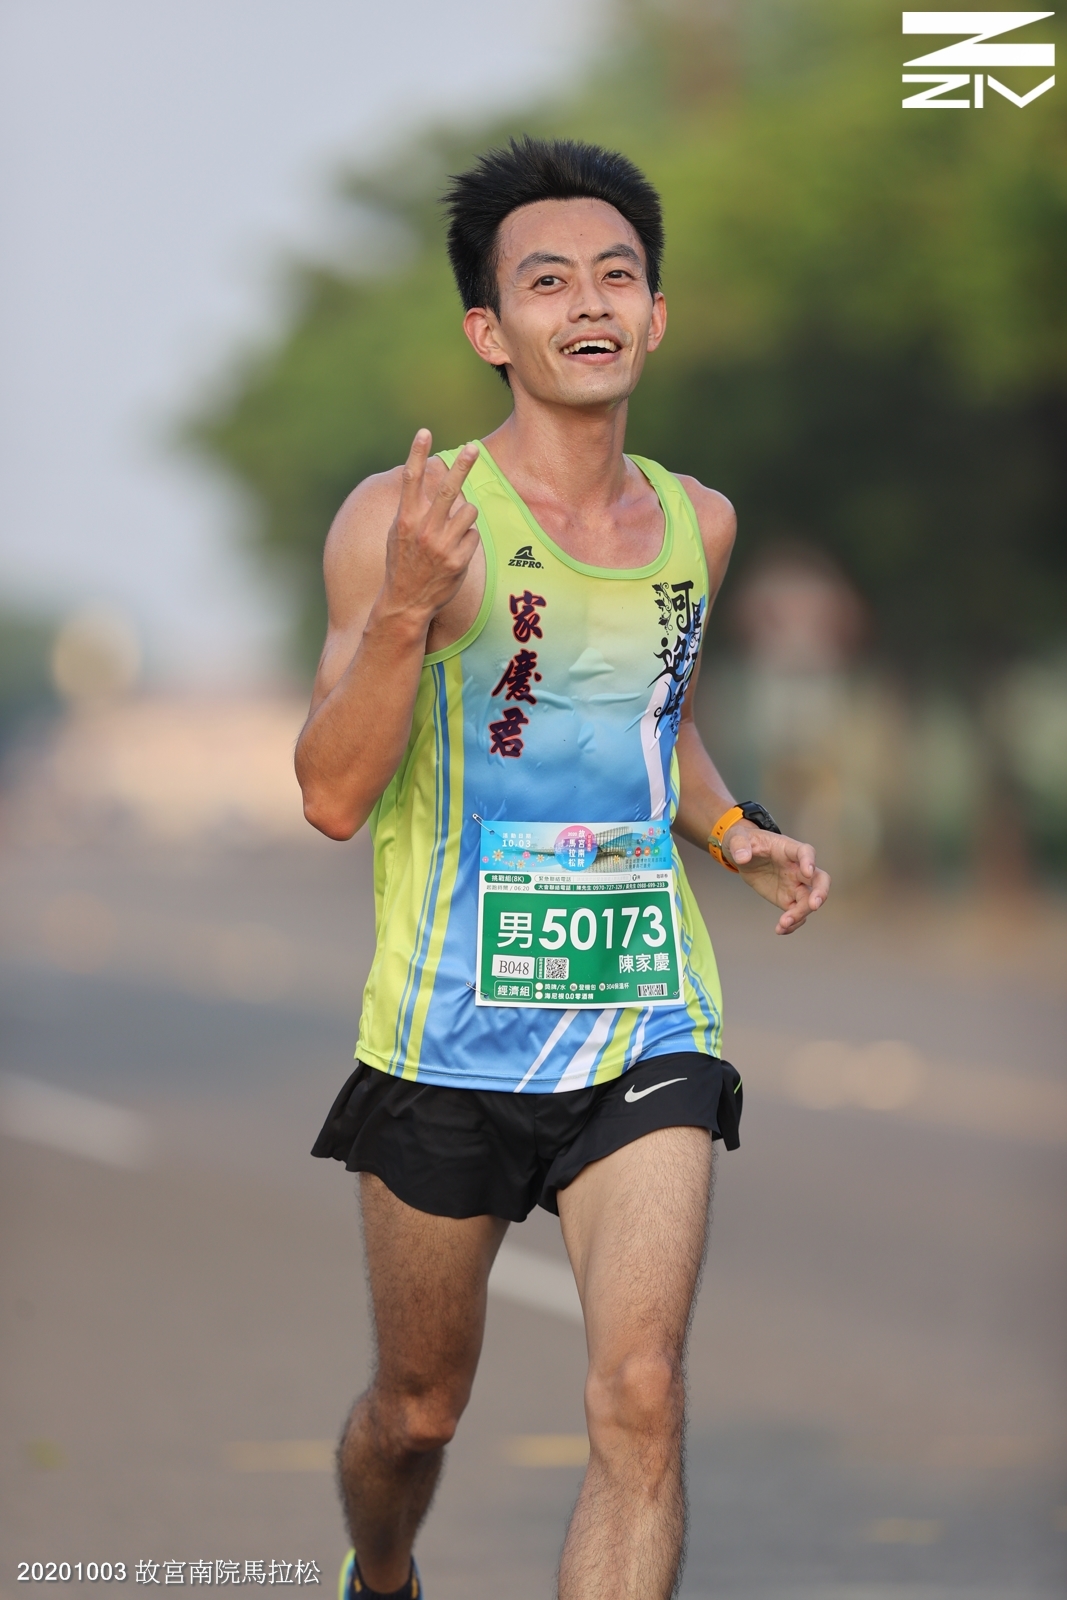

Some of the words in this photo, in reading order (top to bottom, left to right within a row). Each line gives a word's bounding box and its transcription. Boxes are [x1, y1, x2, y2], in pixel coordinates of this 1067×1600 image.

[489, 590, 547, 758] 家慶君
[577, 829, 586, 868] 故宮南院
[498, 959, 530, 976] B048
[618, 952, 671, 974] 陳家慶
[497, 984, 530, 997] 經濟組
